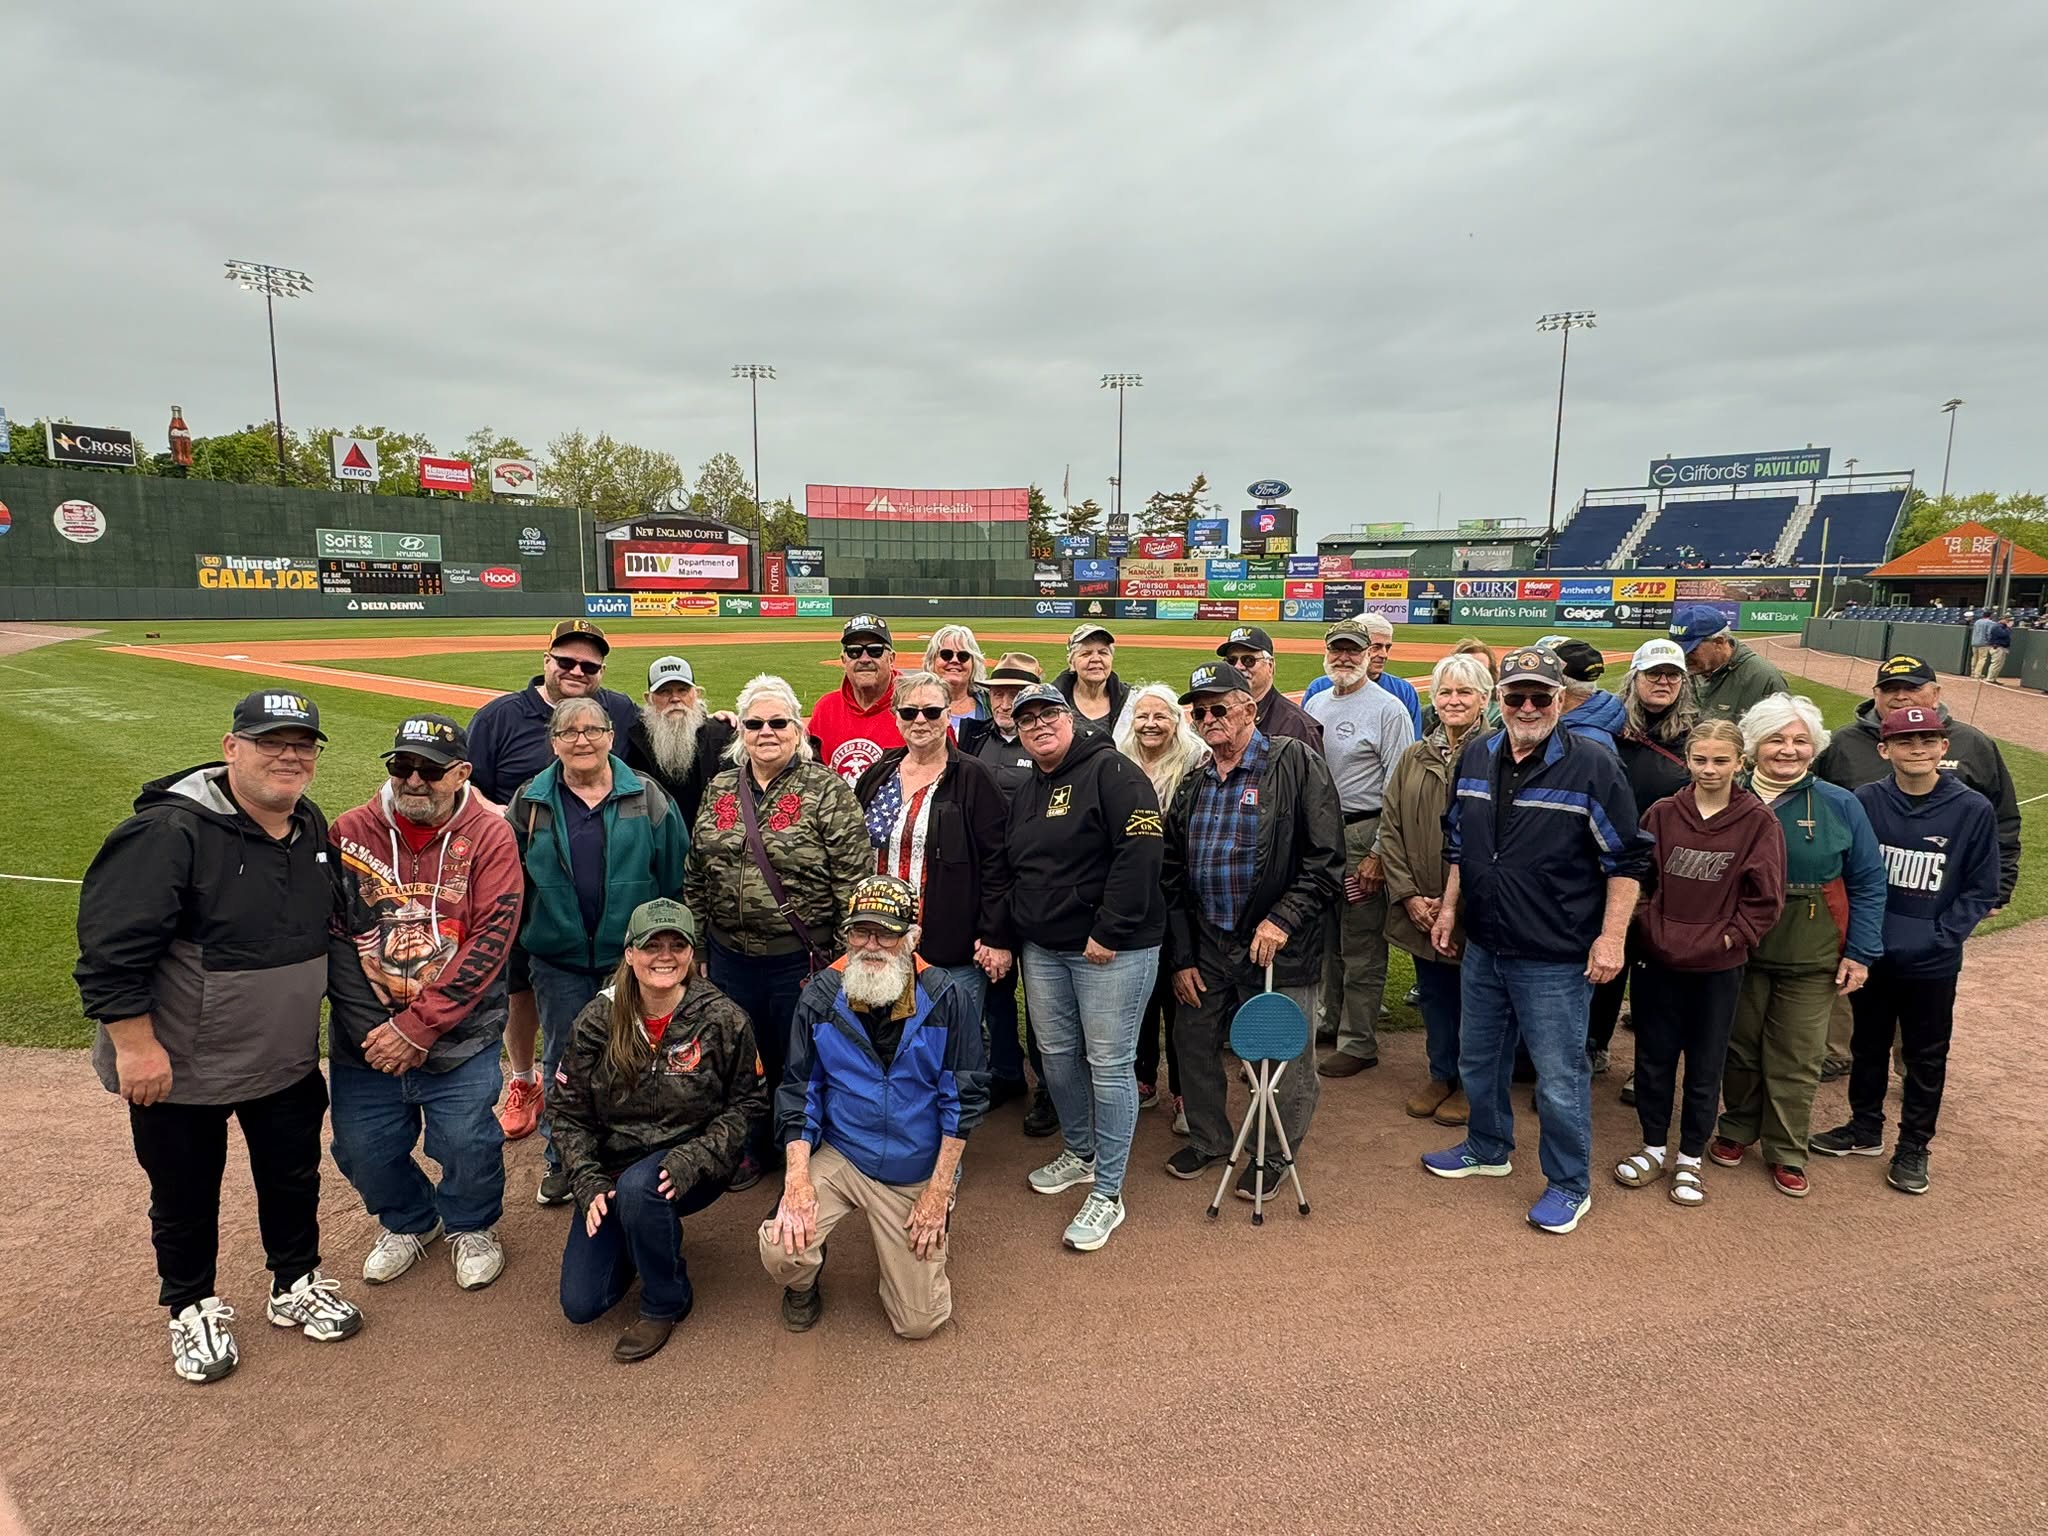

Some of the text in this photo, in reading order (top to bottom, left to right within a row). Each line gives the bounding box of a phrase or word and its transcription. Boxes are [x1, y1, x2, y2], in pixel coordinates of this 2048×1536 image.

[75, 435, 132, 455] CROSS
[342, 467, 372, 478] CITGO
[1679, 462, 1748, 482] Gifford's
[1754, 459, 1820, 478] PAVILION
[1254, 483, 1281, 496] Ford
[898, 502, 973, 514] MaineHealth
[635, 526, 725, 540] NEW ENGLAND COFFEE
[324, 533, 357, 548] SoFi
[225, 556, 291, 573] Injured?
[627, 555, 735, 573] DAV Department of
[484, 572, 516, 583] Hood
[678, 567, 703, 576] Maine
[1237, 583, 1257, 591] CMP
[1456, 581, 1514, 597] QUIRK
[1525, 581, 1553, 590] Motor
[1560, 586, 1594, 594] Anthem
[1637, 582, 1667, 594] VIP
[361, 601, 425, 610] DELTA DENTAL
[798, 600, 830, 609] UniFirst
[1302, 609, 1319, 618] LAW
[1471, 606, 1547, 618] Martin's Point
[1563, 607, 1605, 620] Geiger
[852, 616, 878, 627] DAV
[660, 664, 681, 673] DAV
[264, 695, 309, 711] DAV
[1908, 709, 1924, 722] G
[402, 720, 443, 736] DAV
[1664, 845, 1735, 882] NIKE
[374, 887, 392, 898] ALL
[424, 884, 447, 897] SOE
